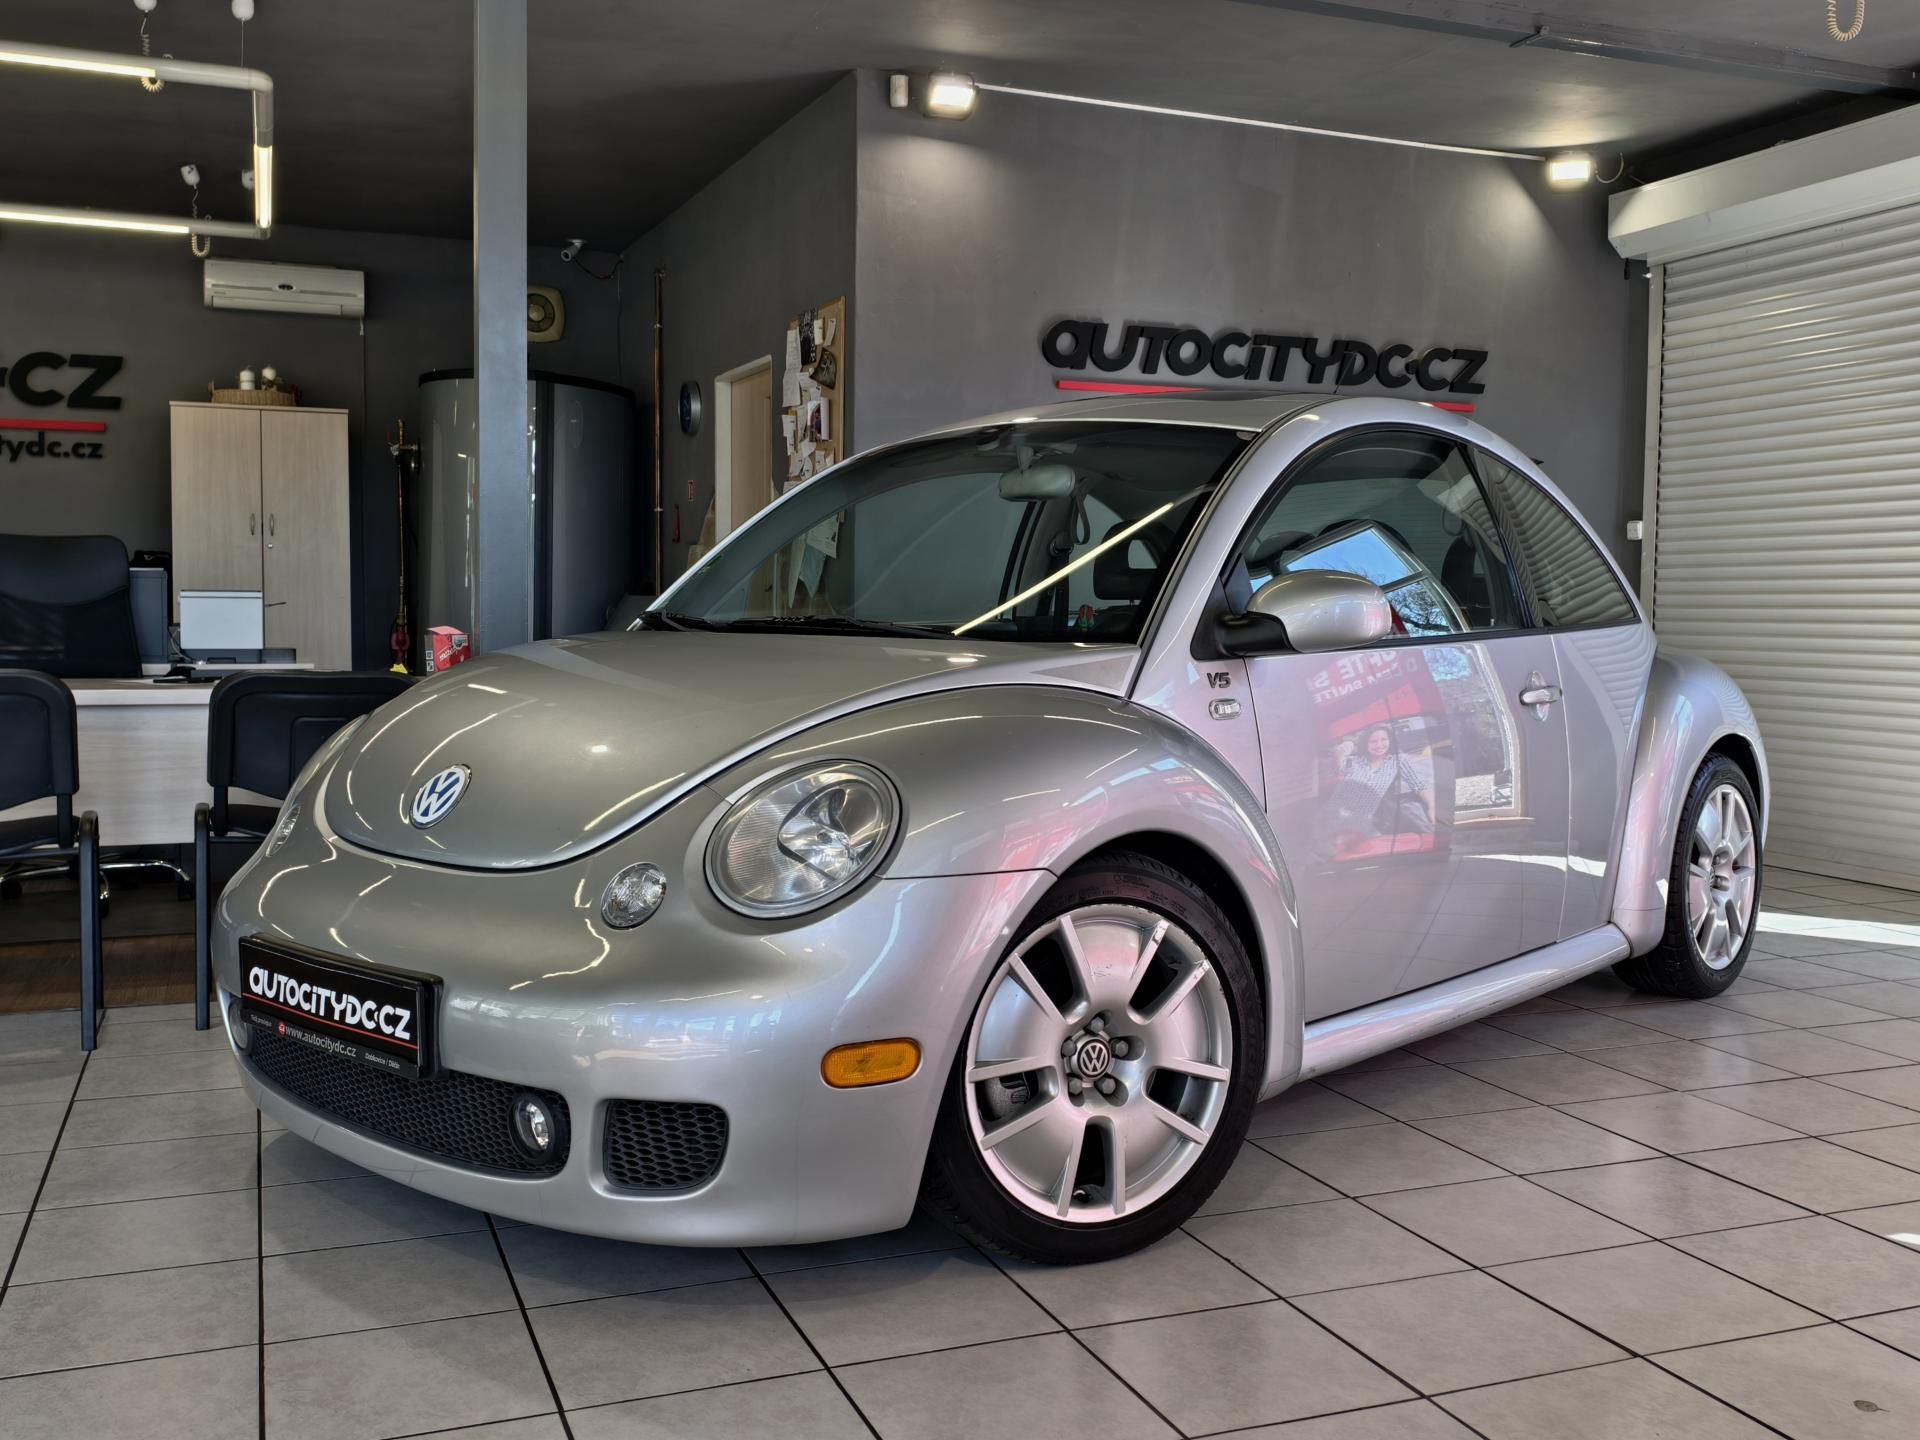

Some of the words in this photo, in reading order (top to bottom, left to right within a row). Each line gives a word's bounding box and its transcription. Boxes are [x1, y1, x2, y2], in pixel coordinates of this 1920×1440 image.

[0, 431, 104, 462] ydc.cz
[1207, 672, 1231, 688] V5
[286, 1026, 357, 1057] www.autocitydc.cz
